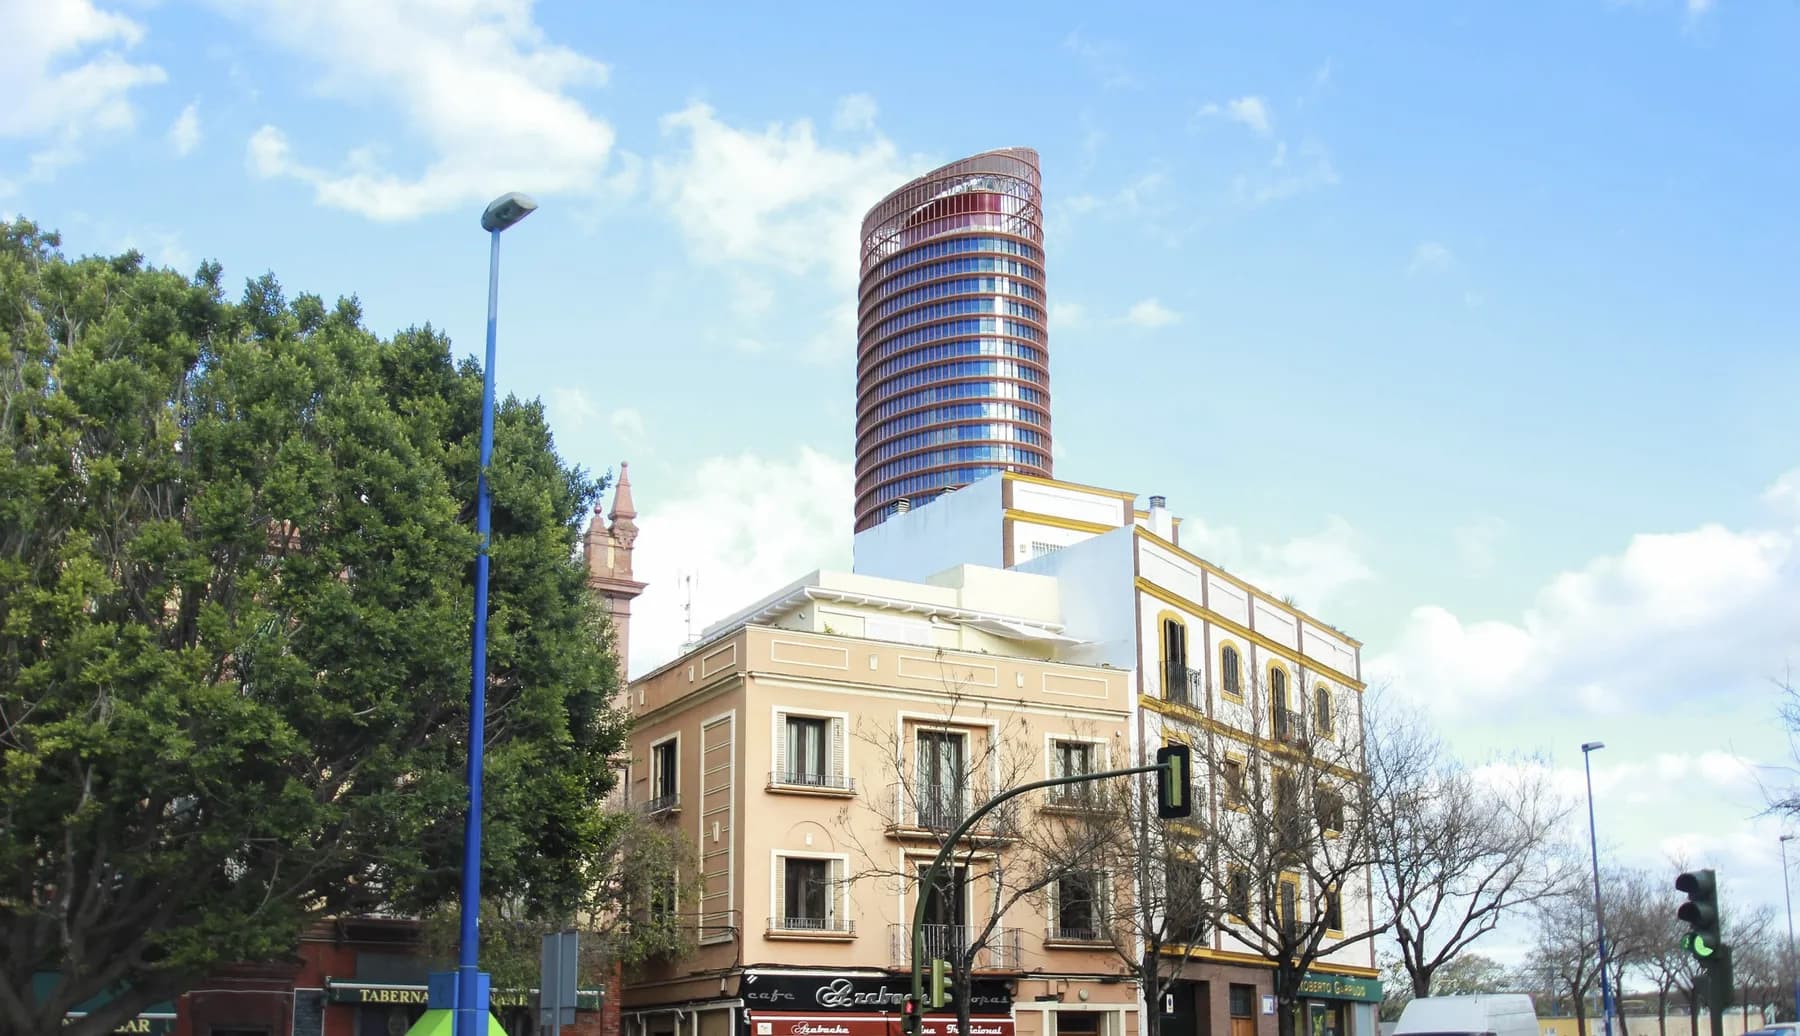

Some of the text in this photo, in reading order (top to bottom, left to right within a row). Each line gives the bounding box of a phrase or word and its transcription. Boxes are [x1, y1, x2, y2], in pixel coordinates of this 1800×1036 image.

[360, 989, 429, 1003] TABERNA
[971, 995, 1009, 1006] opas
[946, 1024, 1002, 1034] Tricional
